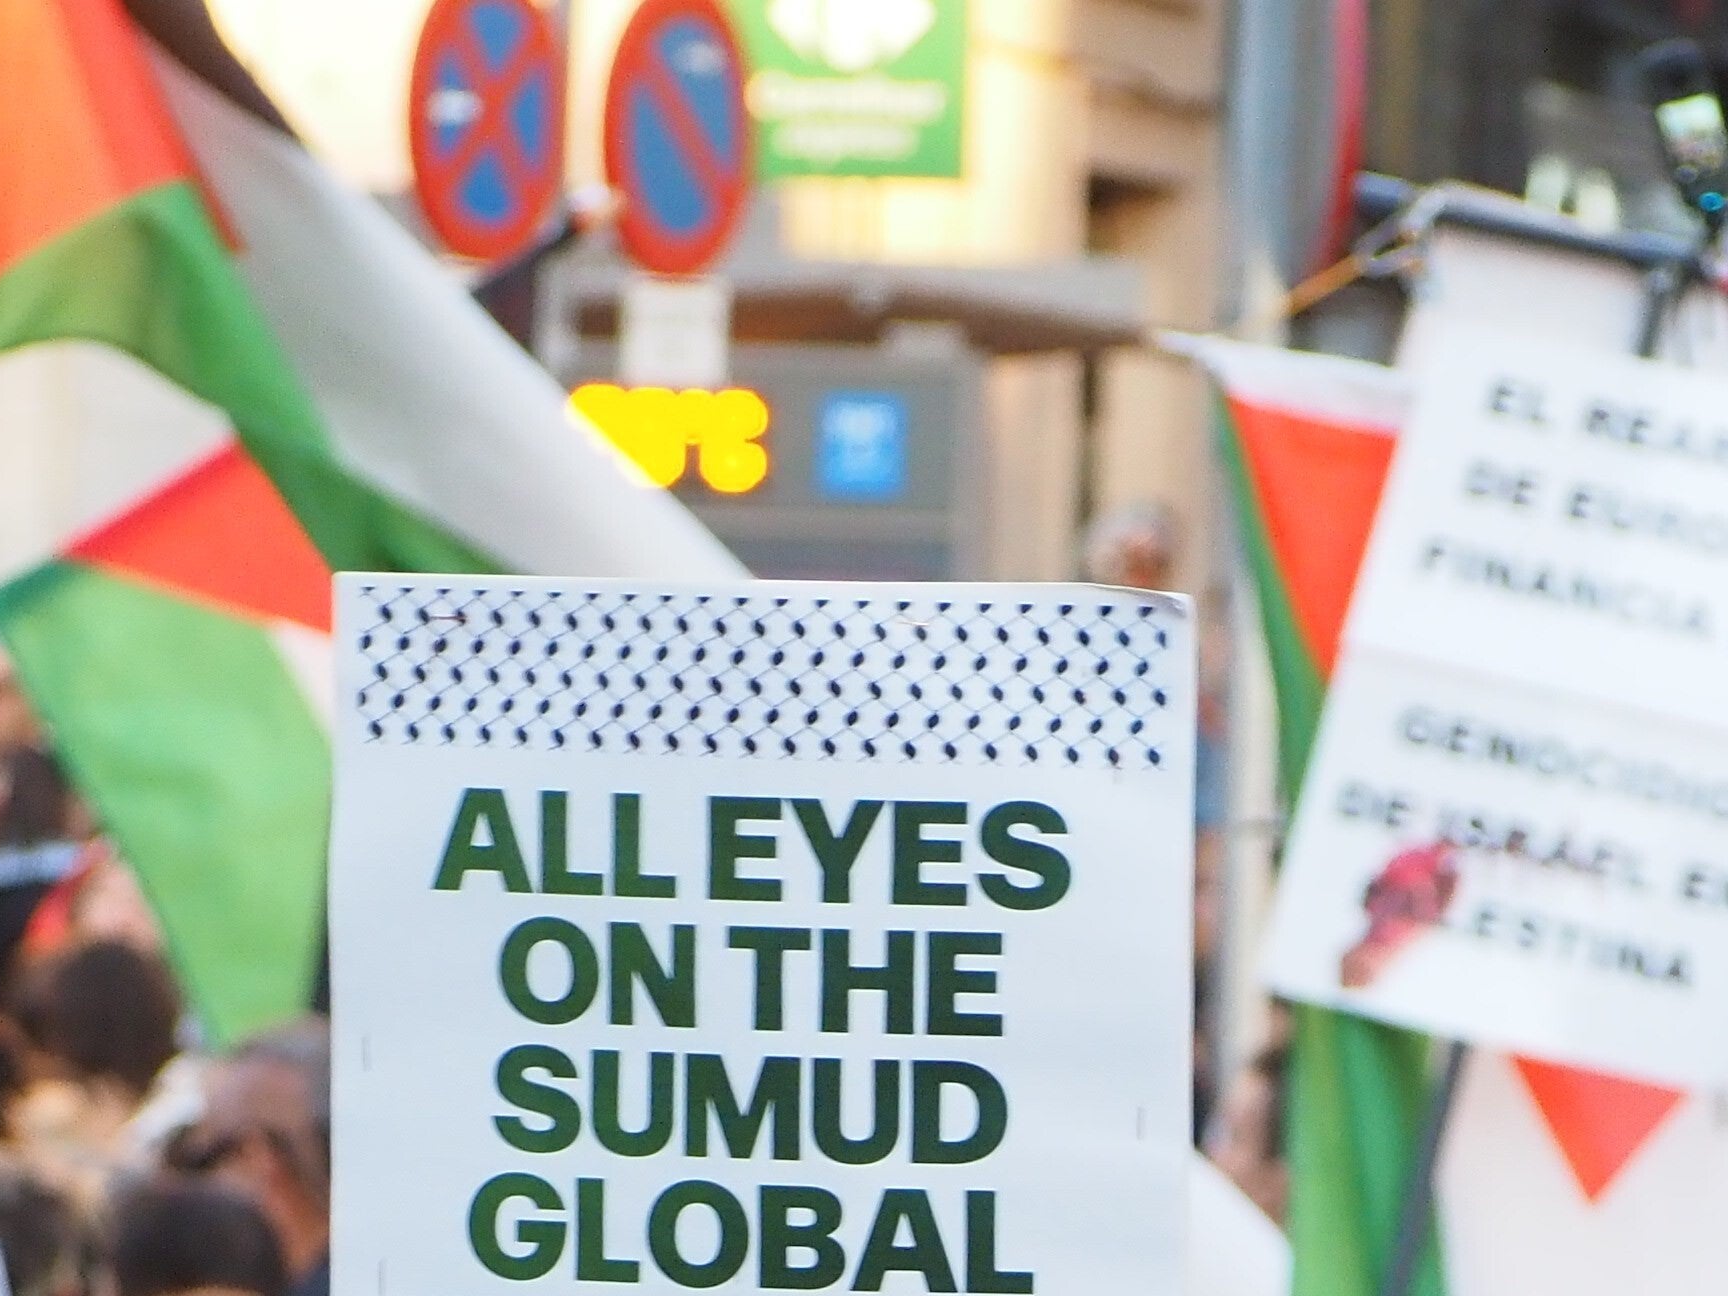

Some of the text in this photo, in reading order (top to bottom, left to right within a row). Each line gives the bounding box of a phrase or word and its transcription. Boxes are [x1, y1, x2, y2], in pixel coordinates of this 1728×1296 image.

[1466, 458, 1535, 507] DE
[432, 787, 1072, 910] ALL EYES
[1338, 781, 1412, 829] DE
[499, 917, 1004, 1037] ON THE
[492, 1043, 1009, 1165] SUMUD
[466, 1172, 1033, 1296] GLOBAL
